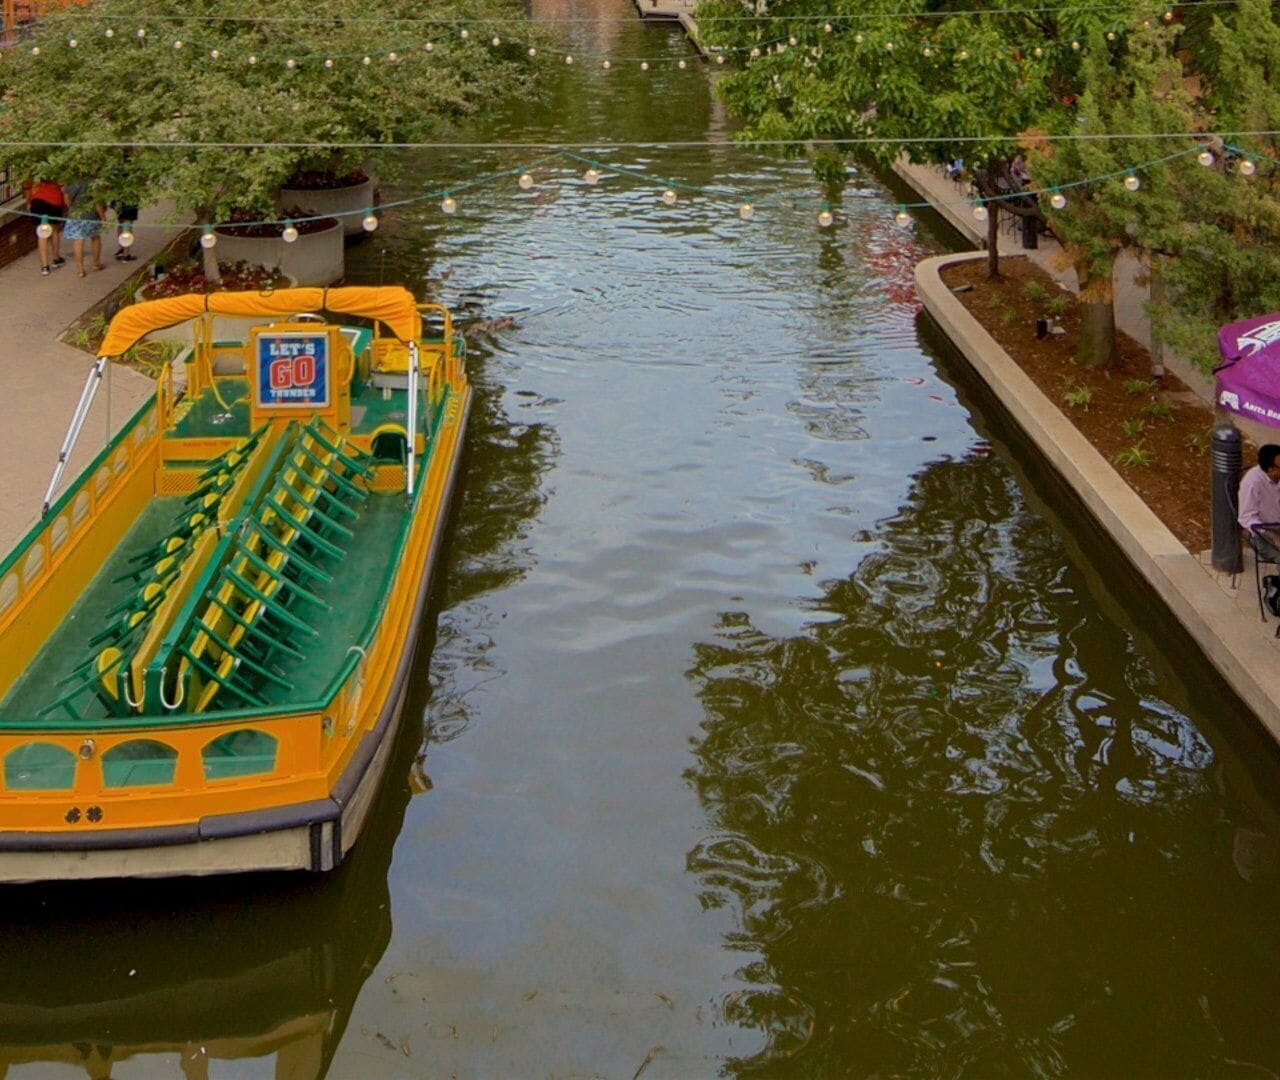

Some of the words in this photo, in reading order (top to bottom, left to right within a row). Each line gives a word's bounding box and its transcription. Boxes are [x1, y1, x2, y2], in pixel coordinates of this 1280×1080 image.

[270, 342, 315, 356] LET'S
[270, 355, 316, 390] GO
[269, 389, 316, 398] THUNDER
